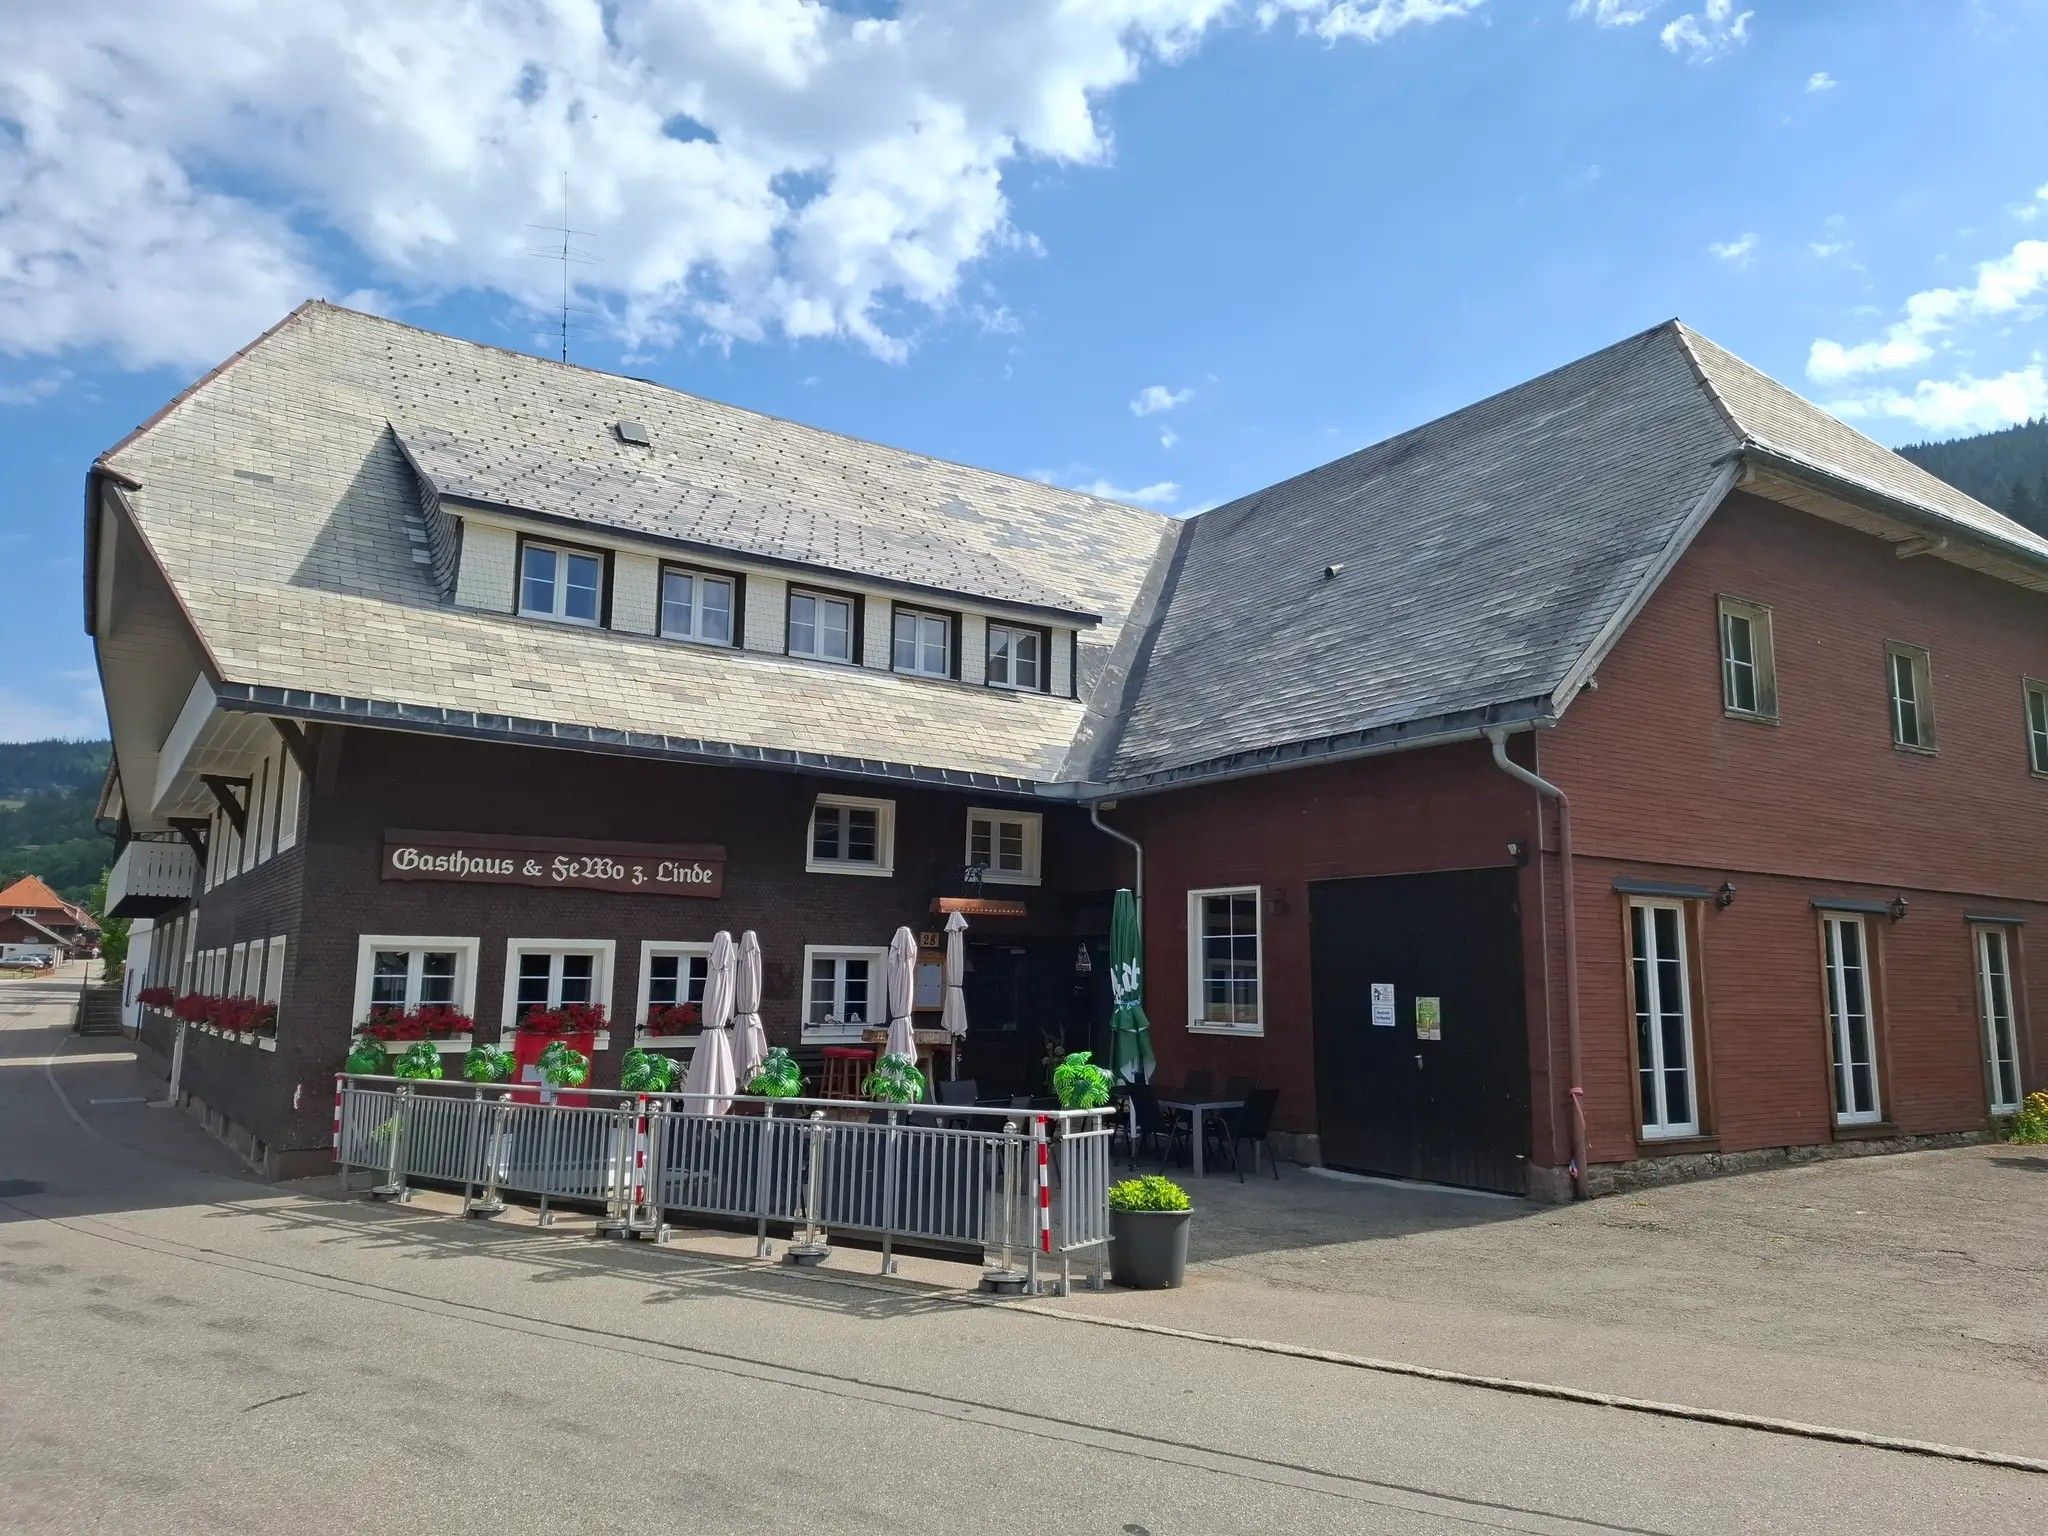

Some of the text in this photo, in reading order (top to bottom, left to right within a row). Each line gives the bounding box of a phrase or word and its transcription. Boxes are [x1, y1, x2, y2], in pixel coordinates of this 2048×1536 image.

[391, 847, 713, 885] Gasthaus & FeWo z. Linde
[922, 934, 936, 946] 28
